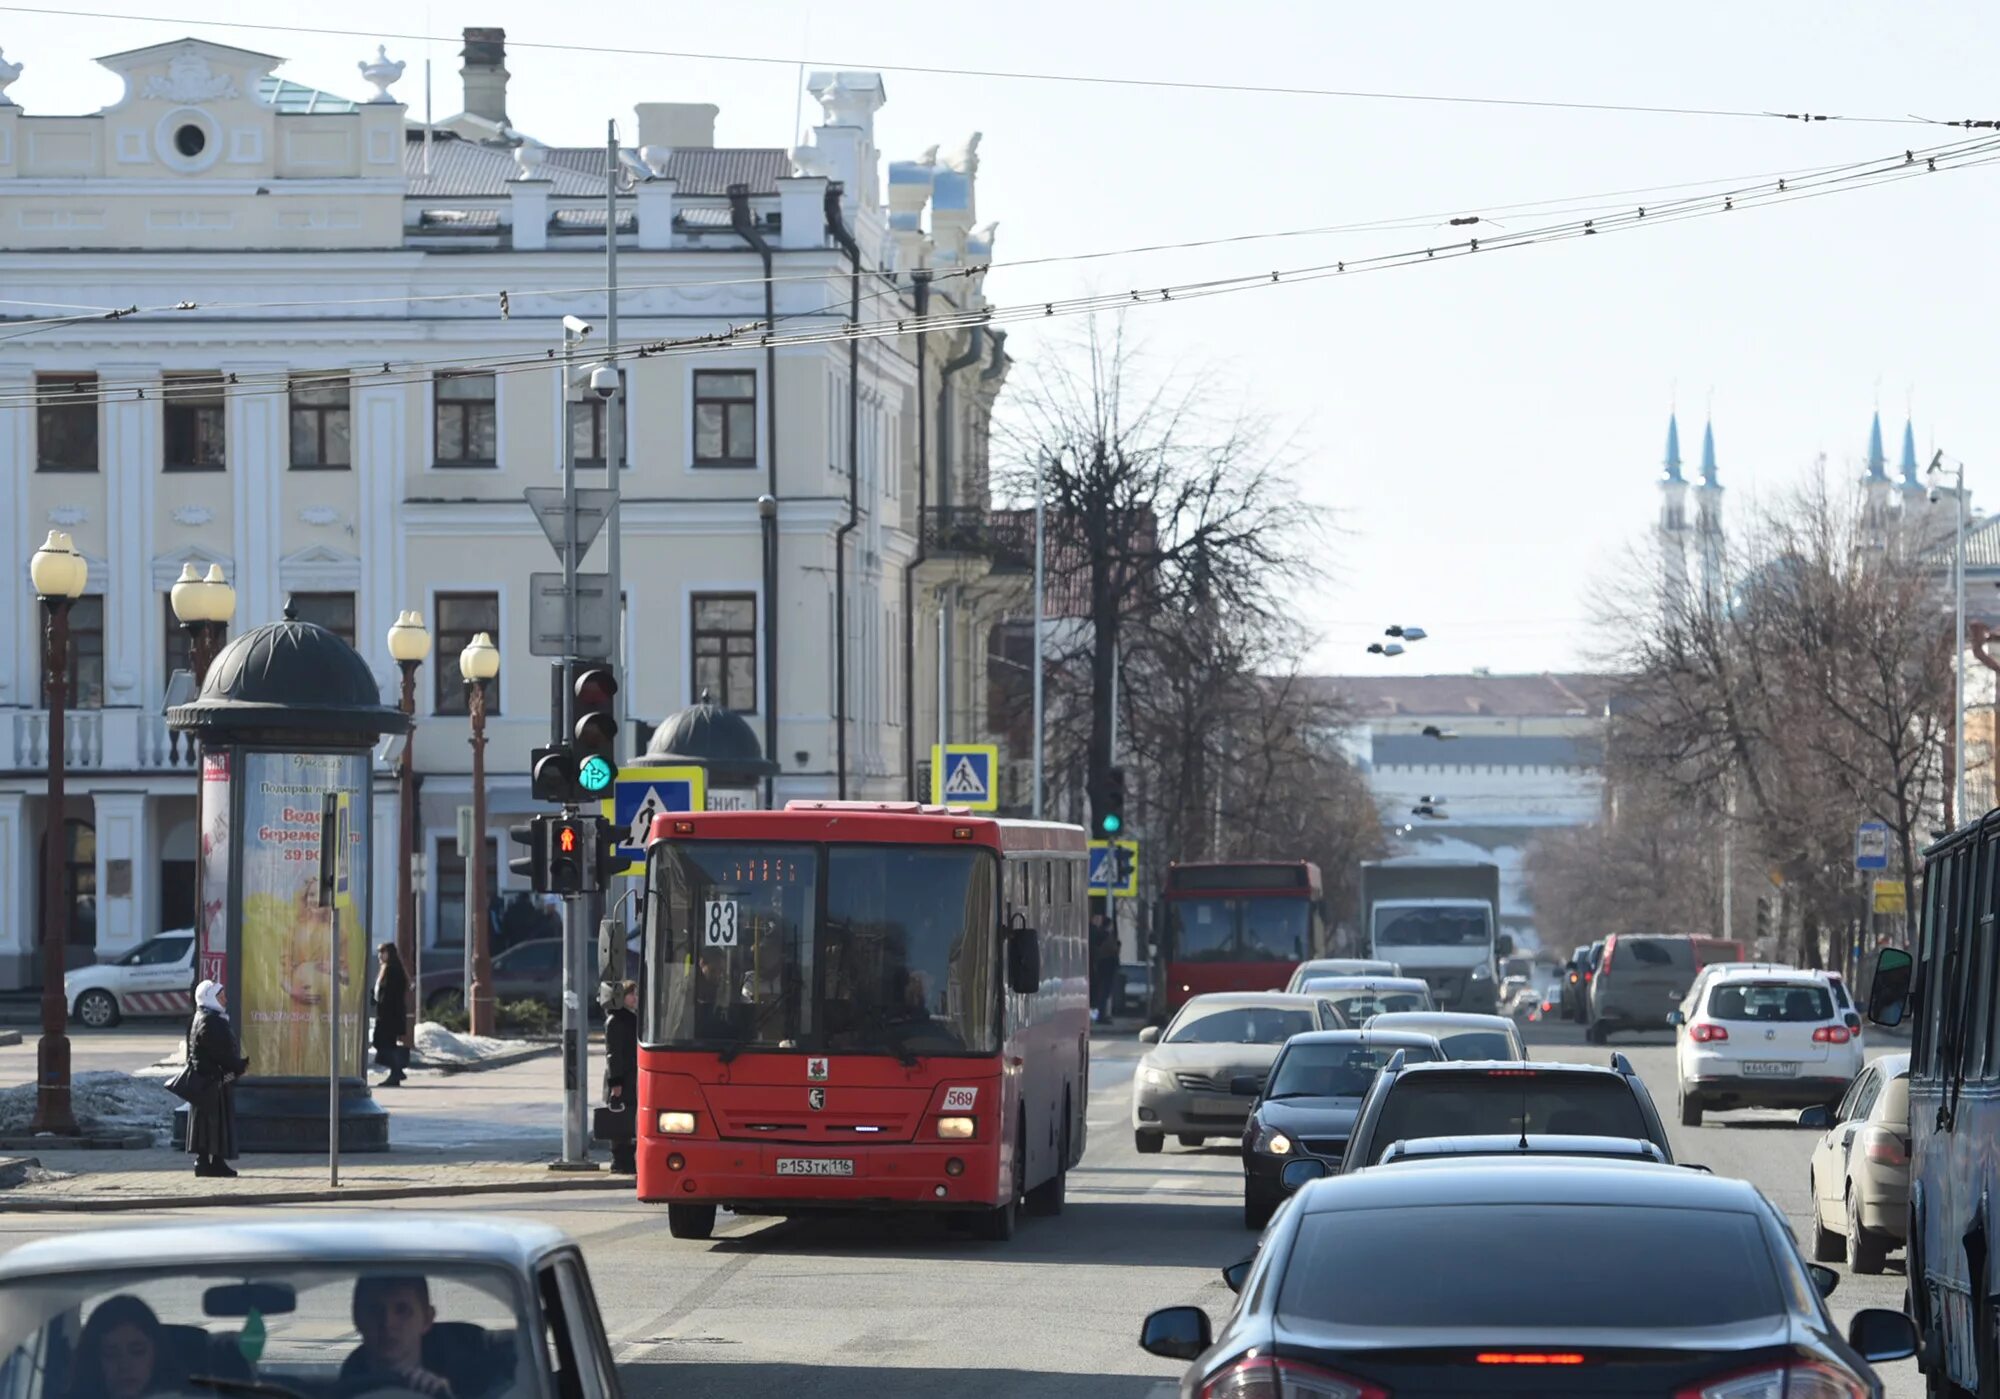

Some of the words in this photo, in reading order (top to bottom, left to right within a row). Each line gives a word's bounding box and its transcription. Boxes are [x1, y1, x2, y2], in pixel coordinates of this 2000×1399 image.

[261, 782, 312, 795] Подарки
[709, 902, 735, 943] 83
[948, 1091, 973, 1106] 569
